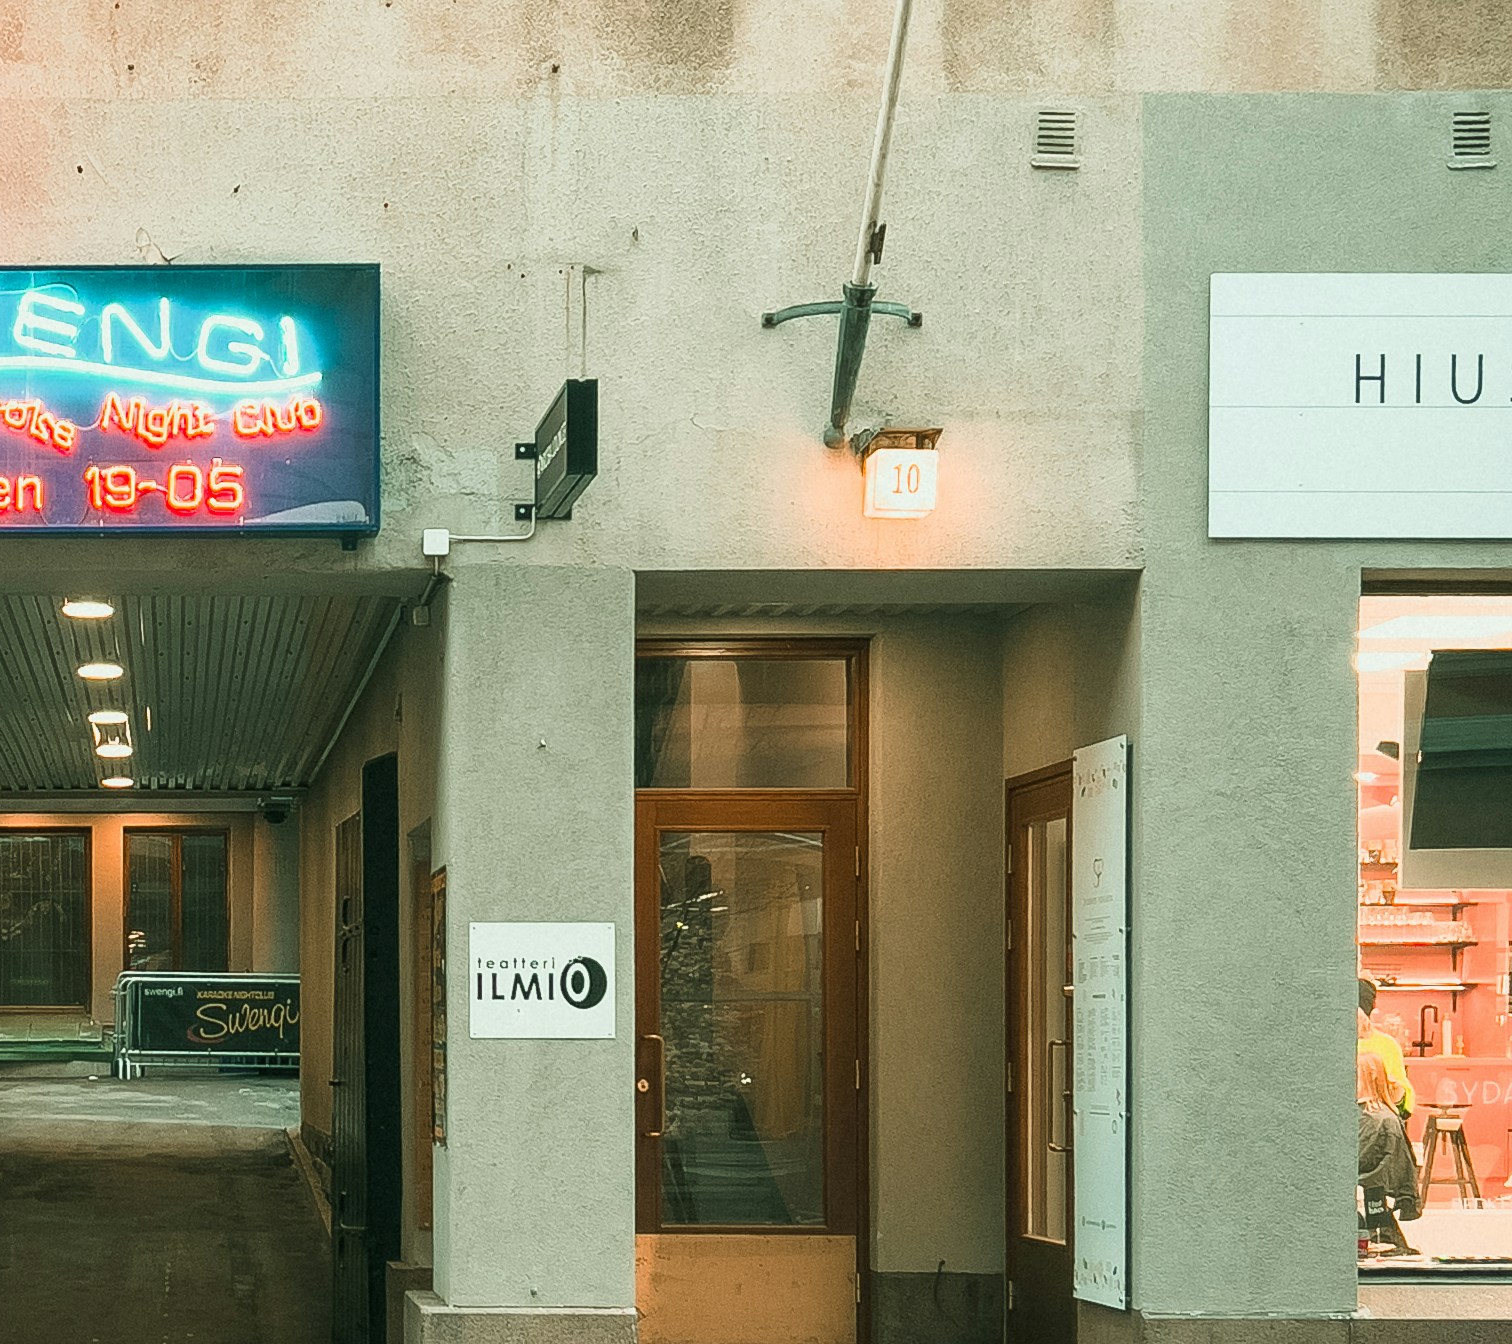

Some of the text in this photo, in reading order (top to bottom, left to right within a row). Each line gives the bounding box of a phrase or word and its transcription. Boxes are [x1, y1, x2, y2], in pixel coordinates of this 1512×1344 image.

[1355, 353, 1512, 405] HIU
[100, 391, 215, 447] Night
[234, 396, 323, 439] Club
[85, 460, 245, 515] 19-05
[892, 463, 921, 494] 10
[477, 957, 556, 970] teatteri
[144, 986, 184, 998] swengi.fi
[196, 999, 300, 1039] Swengi
